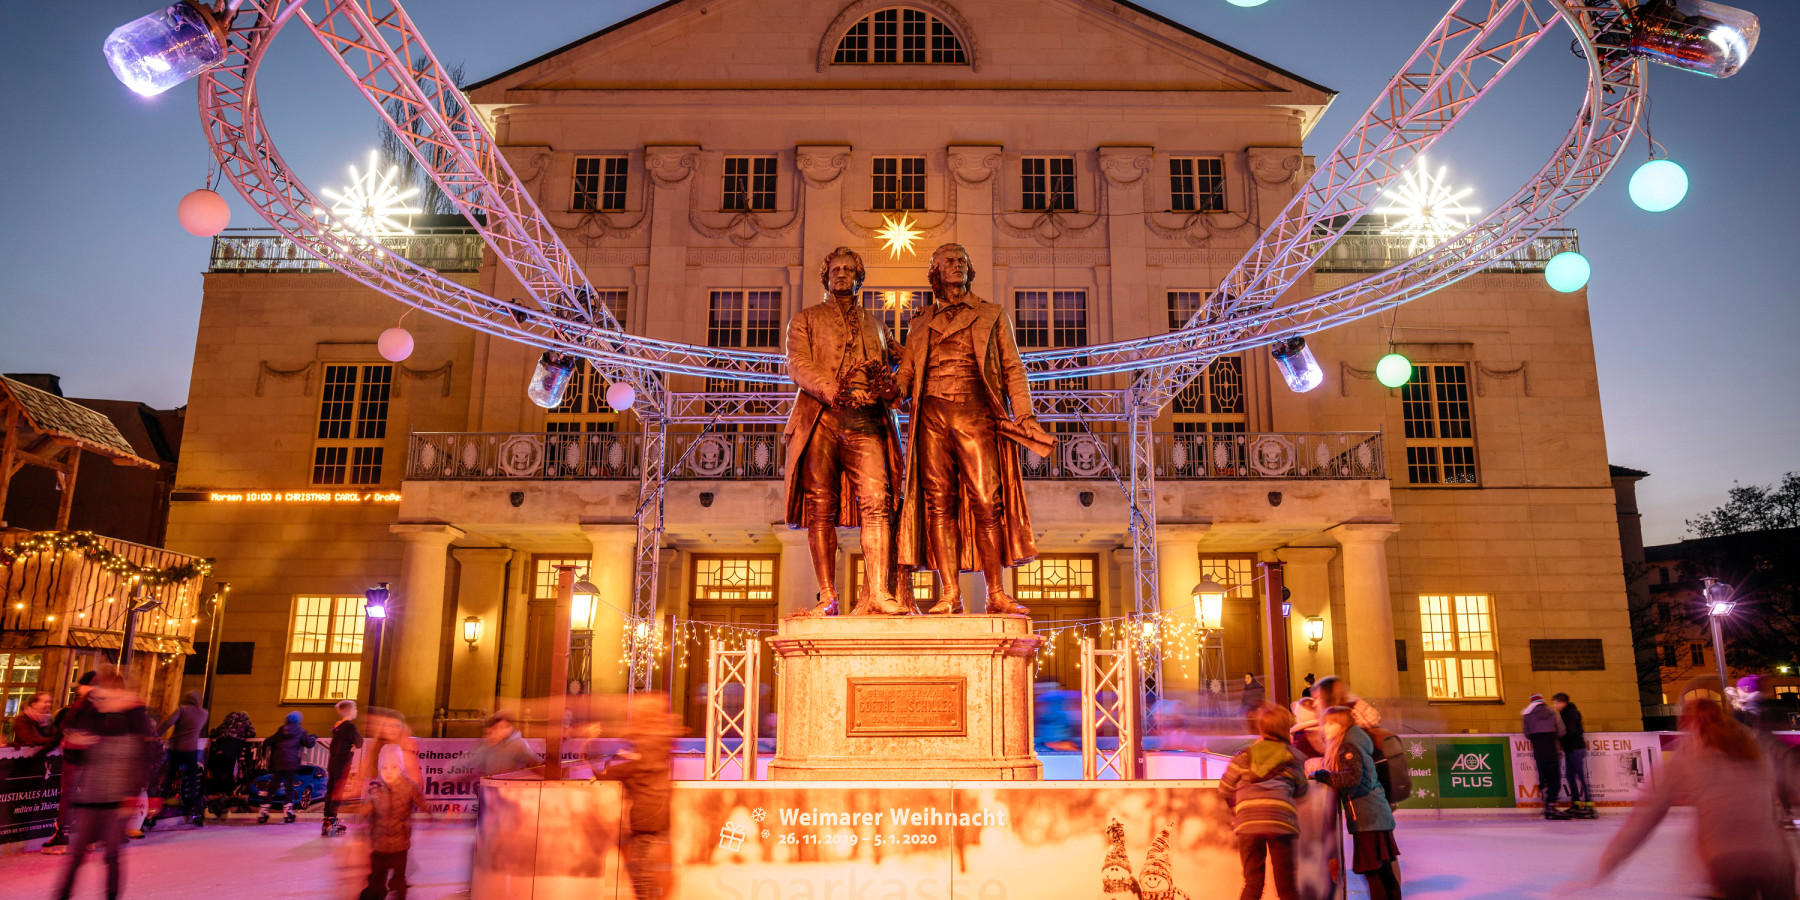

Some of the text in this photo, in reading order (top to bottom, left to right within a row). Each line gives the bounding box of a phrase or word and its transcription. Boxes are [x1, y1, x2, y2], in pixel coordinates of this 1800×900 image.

[246, 493, 272, 501] 10:00
[275, 493, 282, 501] A
[285, 493, 331, 501] CHRISTMAS
[334, 493, 361, 501] CAROL
[859, 700, 895, 713] GOETHE
[908, 700, 954, 713] SCHILLER
[1592, 740, 1611, 751] SIE
[1612, 740, 1632, 751] EIN
[1451, 753, 1491, 770] AOK
[426, 765, 444, 774] ins
[447, 765, 475, 774] Jahr
[1452, 776, 1493, 788] PLUS
[779, 807, 1006, 826] Weimarer Weihnacht
